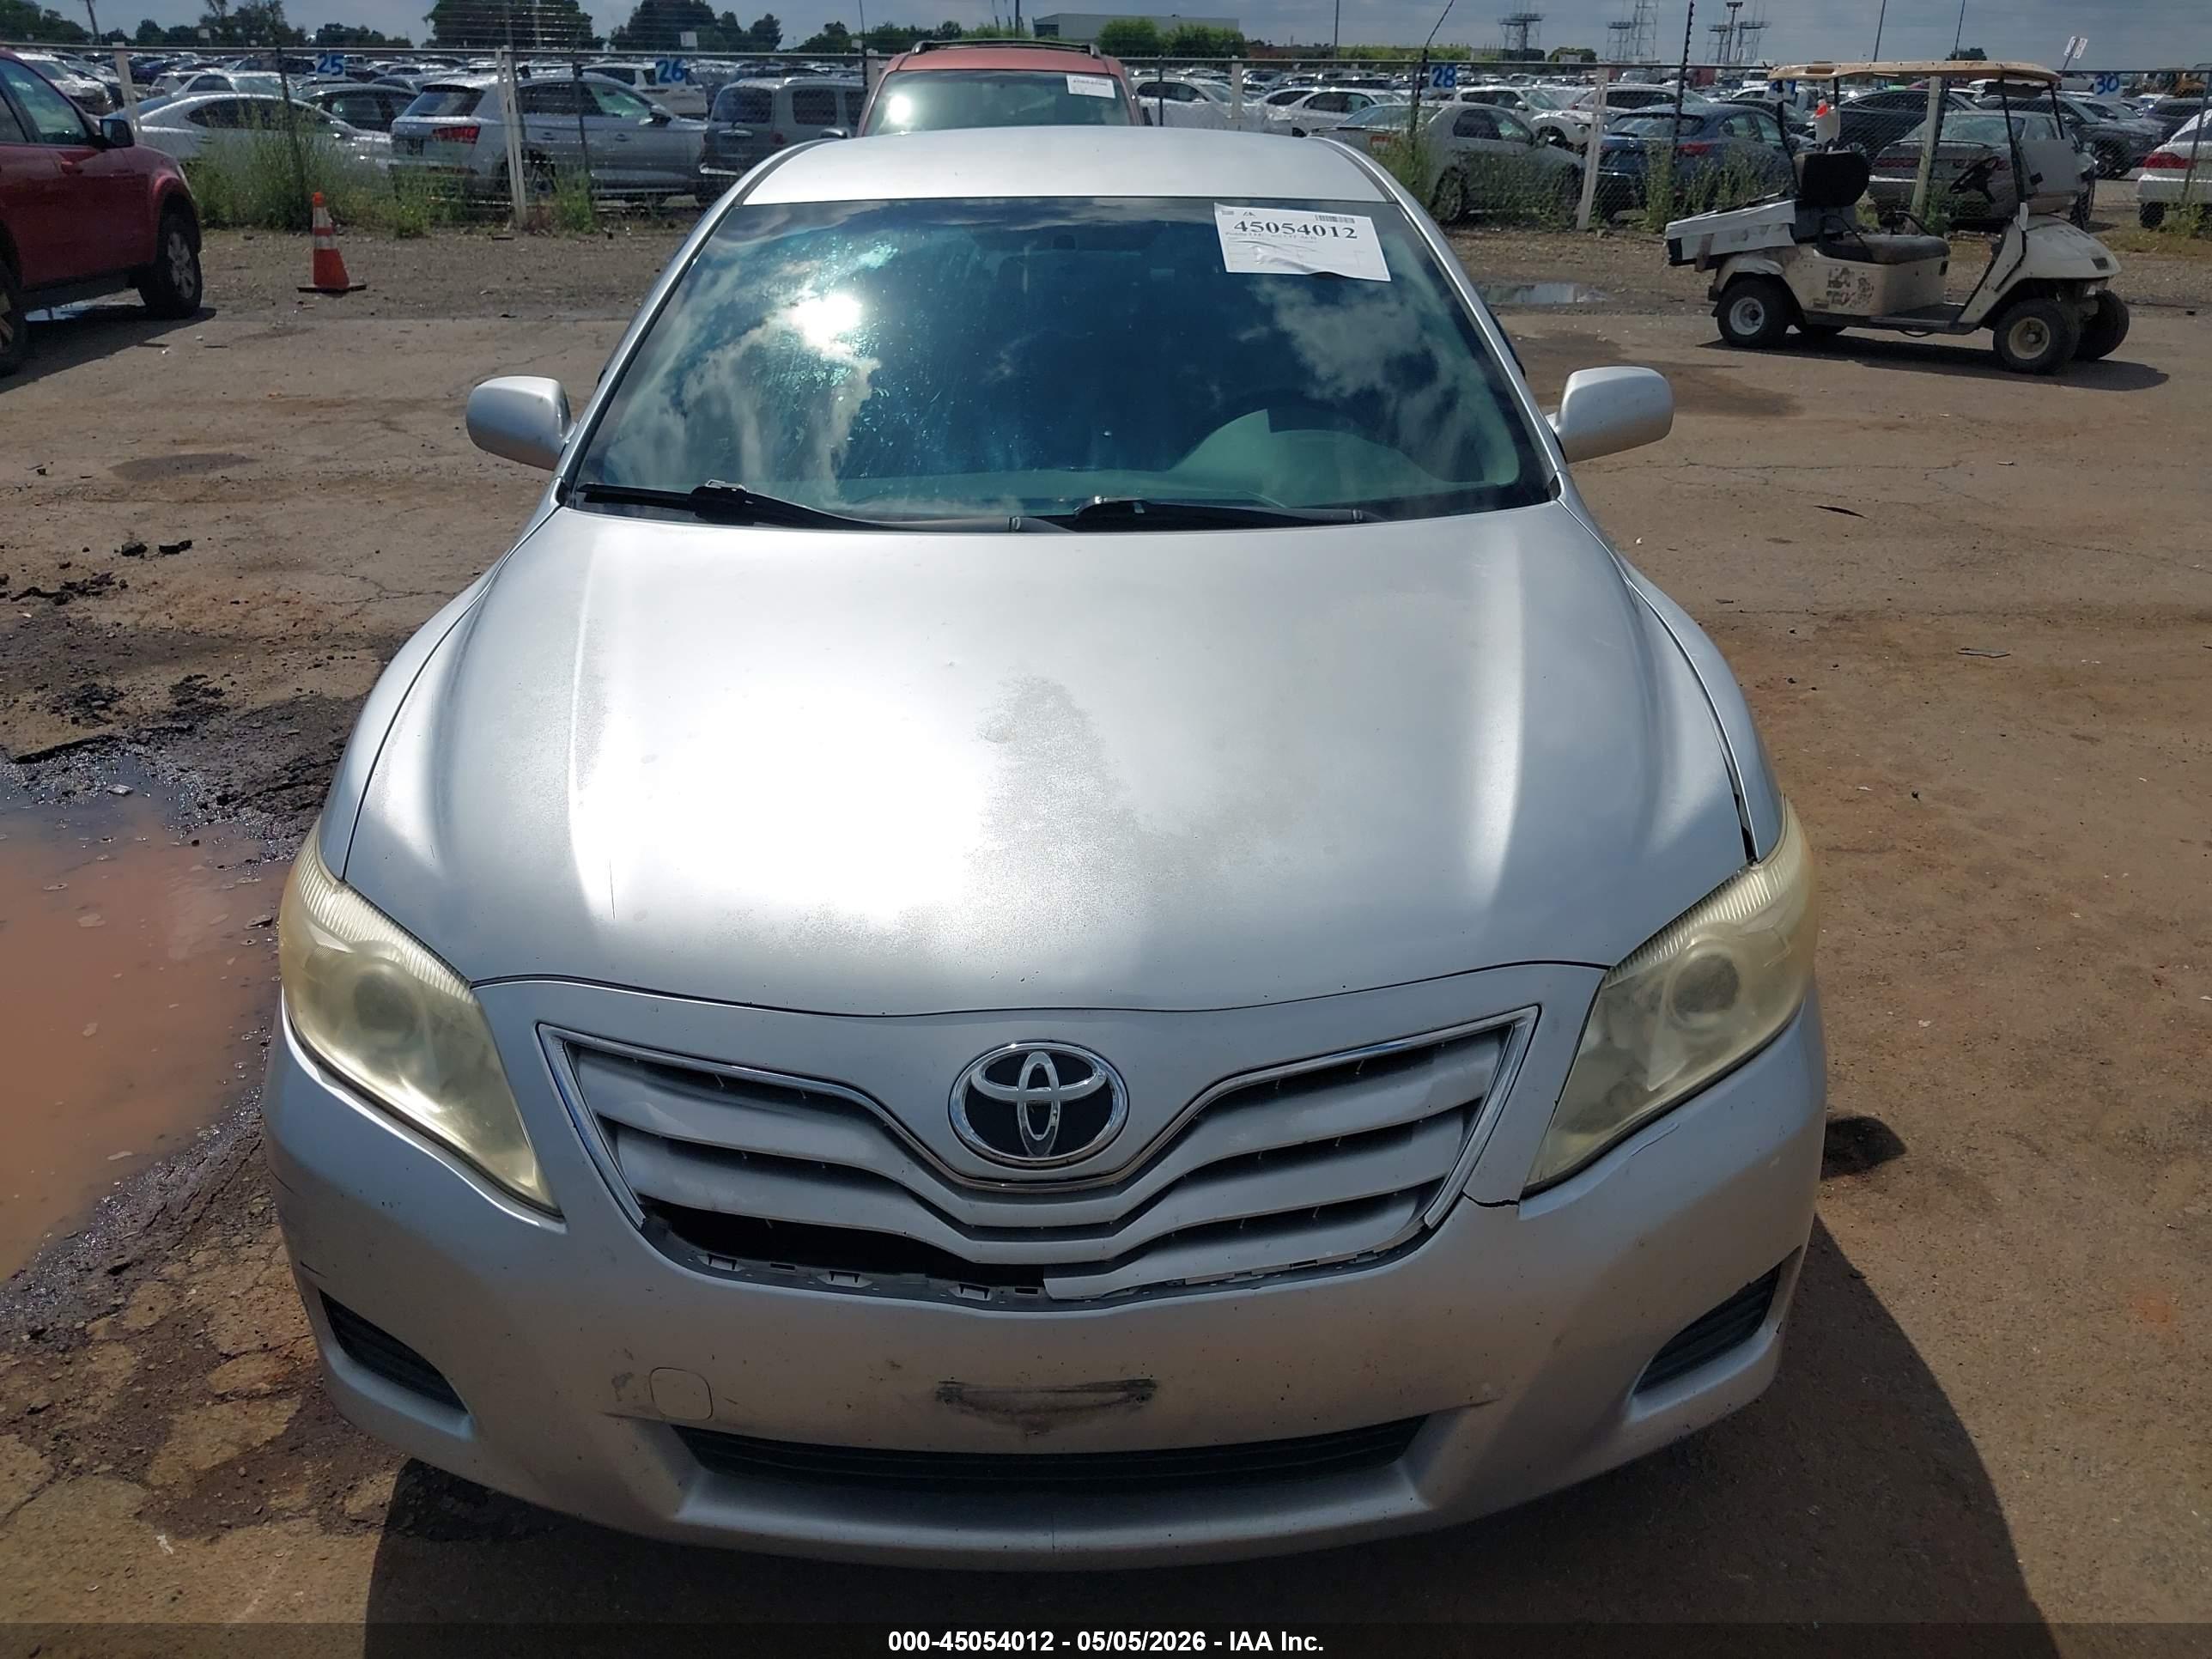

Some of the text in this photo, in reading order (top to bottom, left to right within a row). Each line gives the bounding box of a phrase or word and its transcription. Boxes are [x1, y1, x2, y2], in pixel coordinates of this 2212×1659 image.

[317, 52, 343, 76] 25
[656, 57, 685, 83] 26
[1431, 66, 1456, 88] 28
[2094, 74, 2120, 95] 30
[1234, 221, 1358, 240] 45054012
